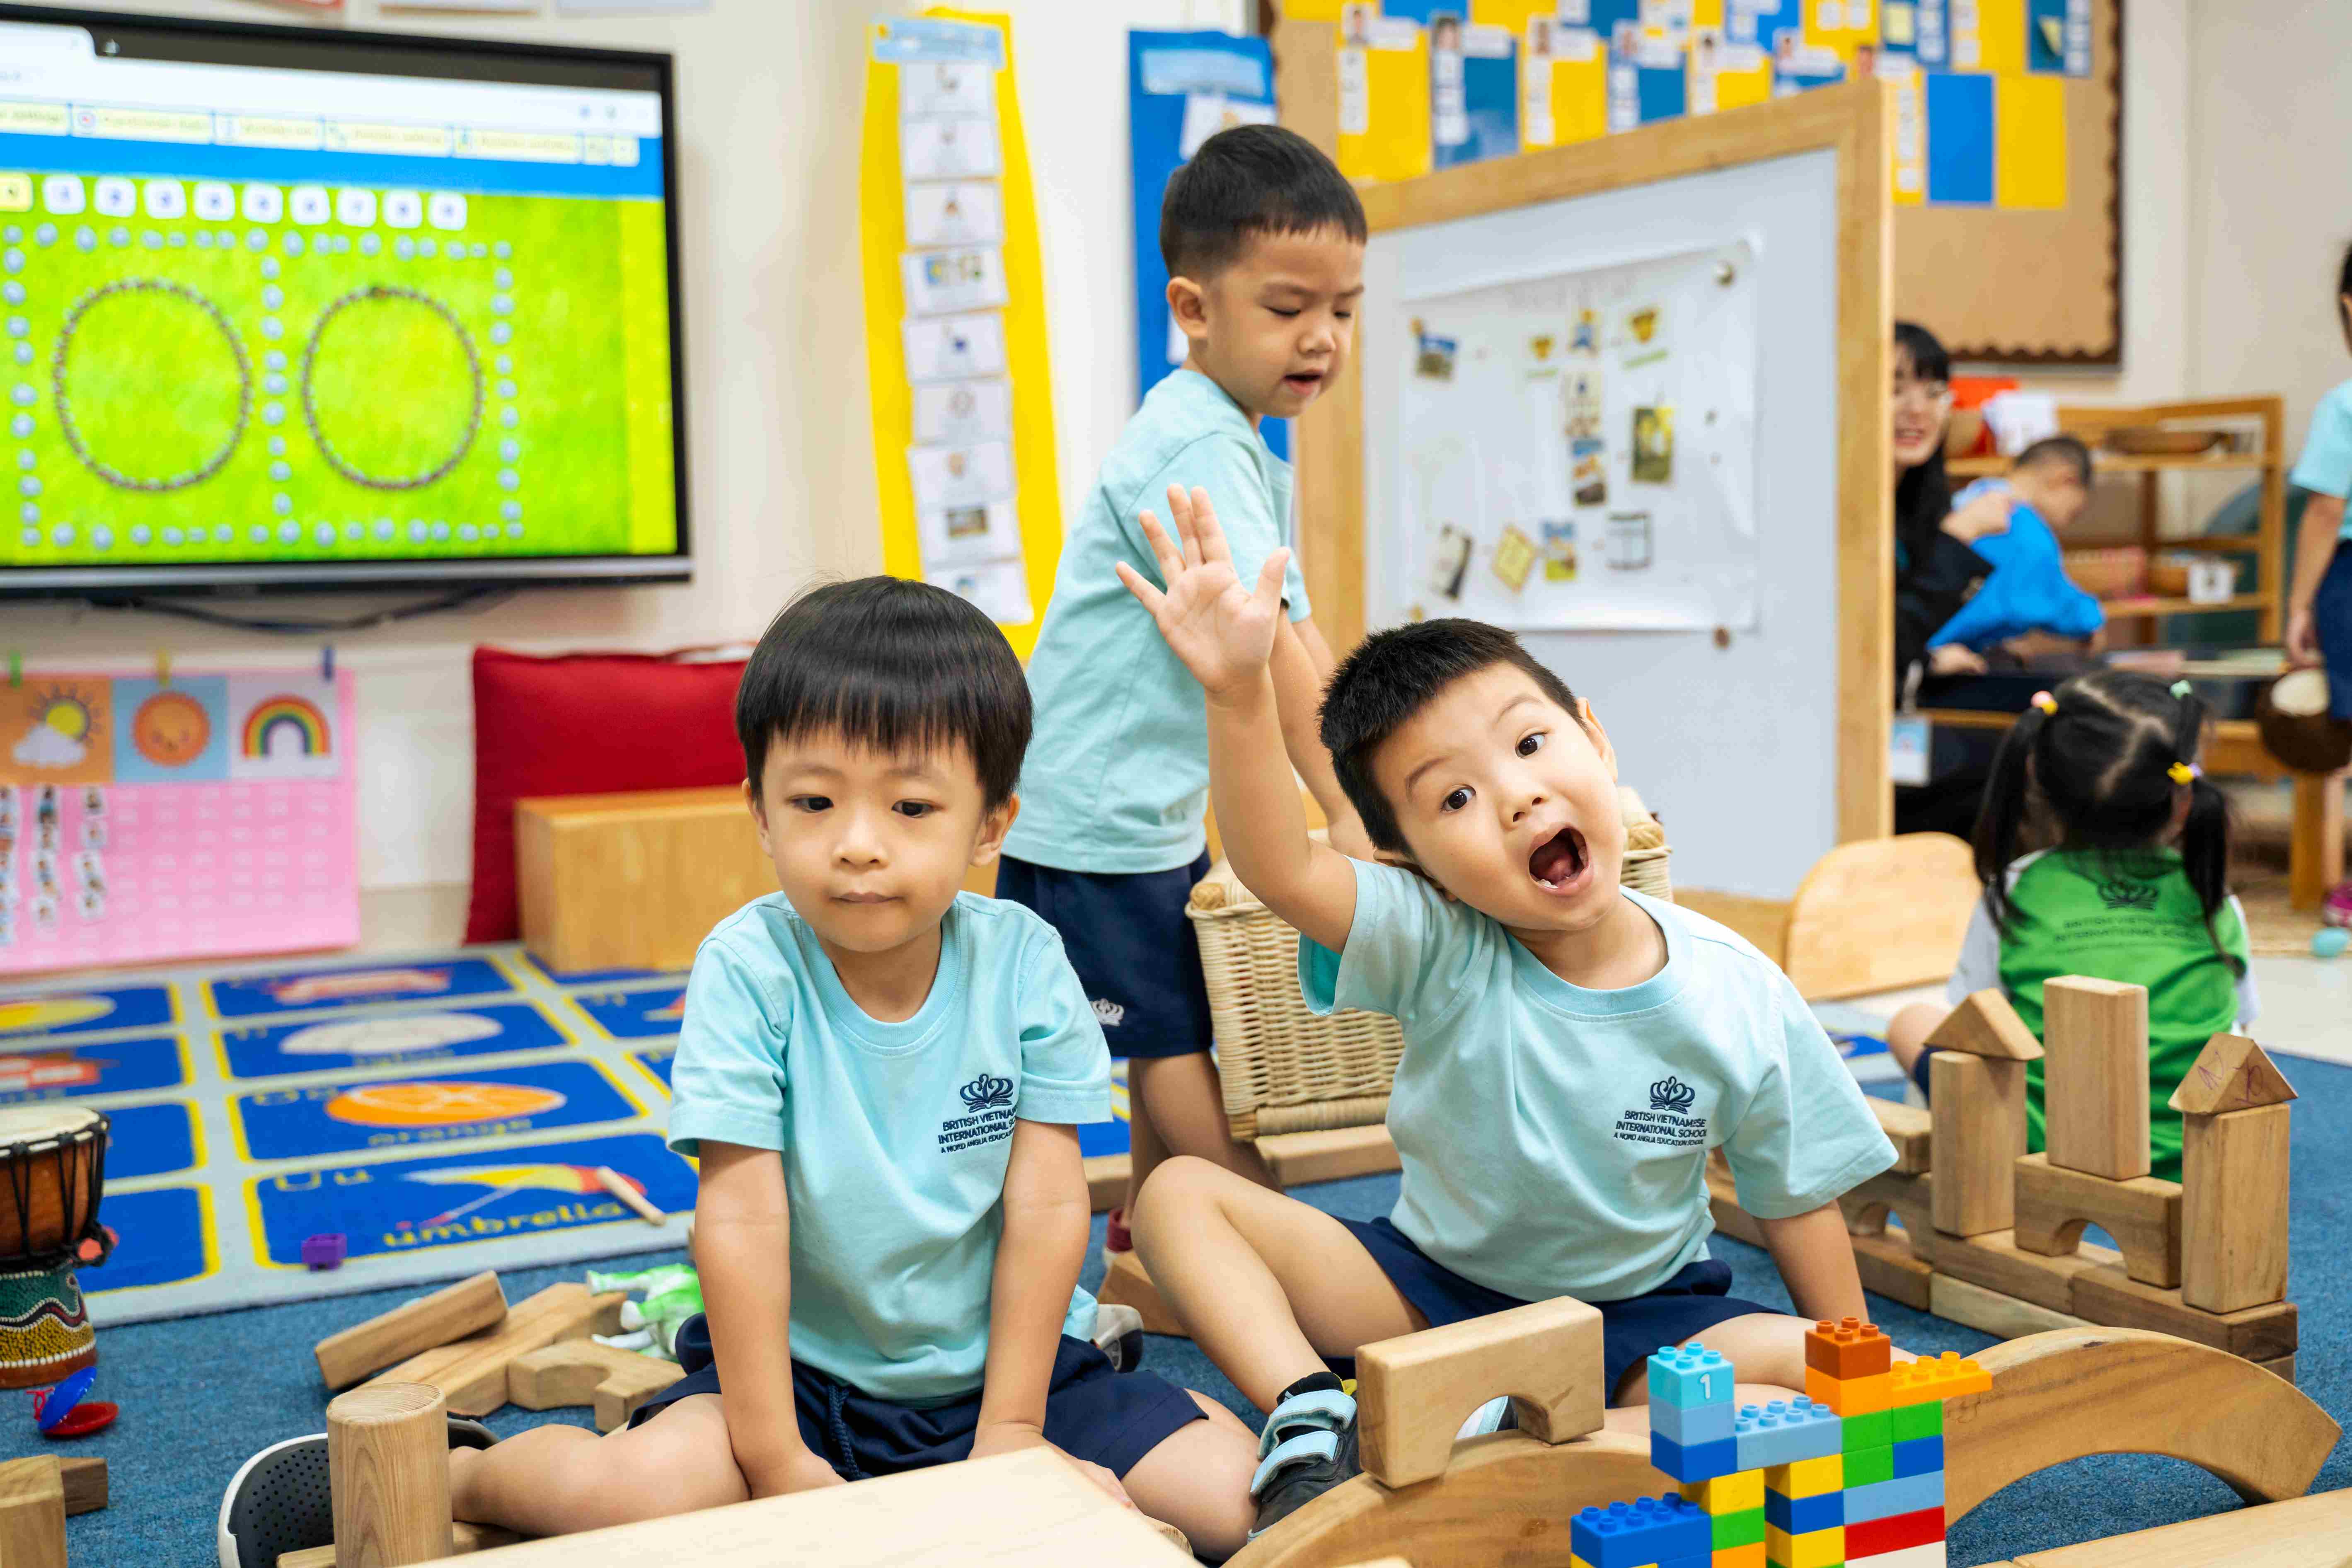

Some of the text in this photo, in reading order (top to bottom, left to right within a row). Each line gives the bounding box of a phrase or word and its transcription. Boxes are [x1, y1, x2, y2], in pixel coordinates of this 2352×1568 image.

[943, 1115, 979, 1131] BRITISH
[1624, 1111, 1706, 1128] BRITISH VIETNAMESE
[938, 1122, 1009, 1144] INTERNATIONAL
[1616, 1121, 1707, 1138] INTERNATIONAL SCHOOL
[967, 1137, 988, 1147] ANGLIA
[383, 1203, 625, 1246] umbrella
[1700, 1373, 1711, 1399] 1
